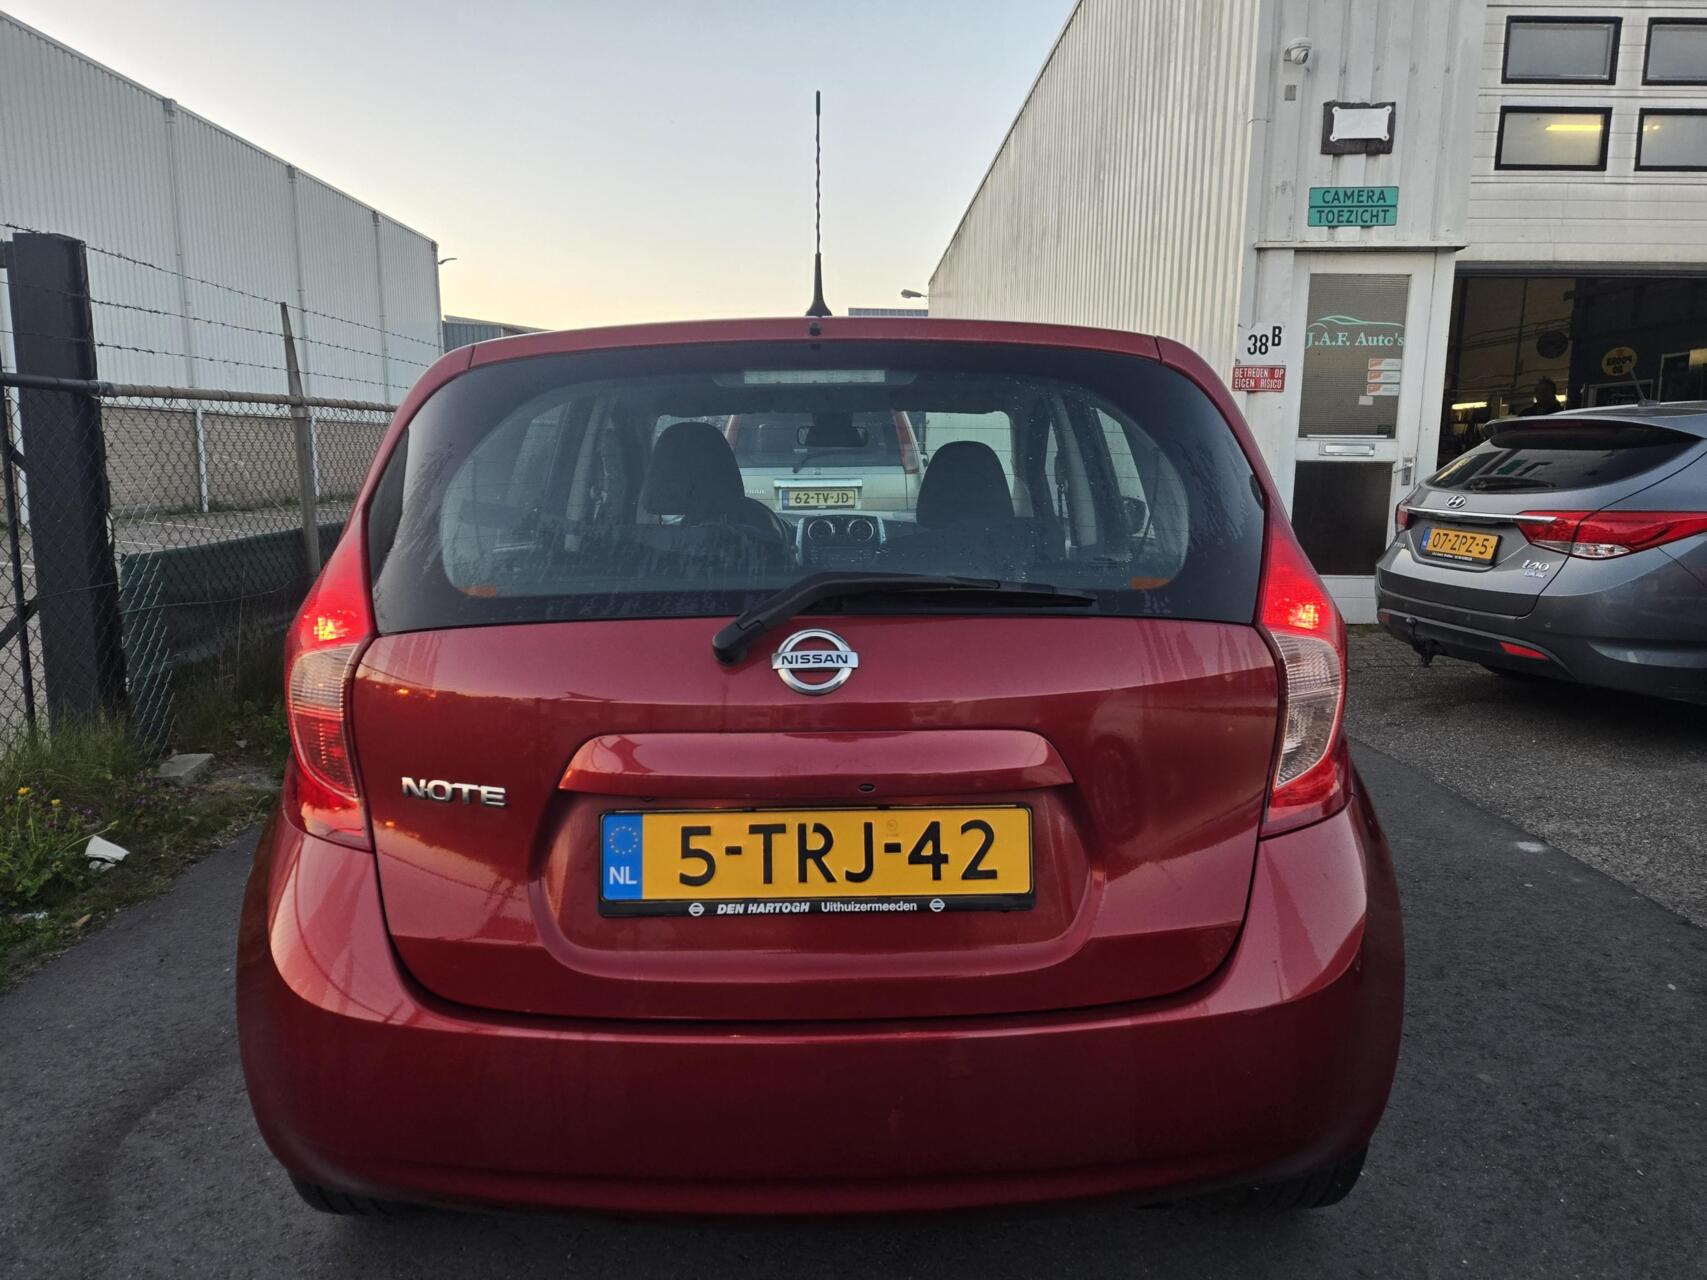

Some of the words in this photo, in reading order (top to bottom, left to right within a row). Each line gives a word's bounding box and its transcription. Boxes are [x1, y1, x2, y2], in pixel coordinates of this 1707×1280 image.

[1322, 189, 1387, 204] CAMERA
[1316, 209, 1390, 224] TOEZICHT
[1305, 332, 1351, 349] J.A.F.
[1354, 332, 1405, 346] Auto's
[1234, 367, 1269, 378] BETREDEN
[1274, 368, 1285, 378] OP
[1234, 378, 1255, 389] EIGEN
[1260, 379, 1282, 389] RISICO
[794, 492, 850, 504] 62-TV-JD
[1432, 532, 1490, 555] 07-ZPZ-5
[781, 654, 848, 665] NISSAN
[401, 776, 506, 806] NOTE
[679, 819, 998, 887] 5-TRJ-42
[608, 866, 637, 885] NL
[716, 904, 744, 915] DEN
[747, 902, 811, 914] HARTOGH
[821, 901, 918, 912] Uithuizermeeden
